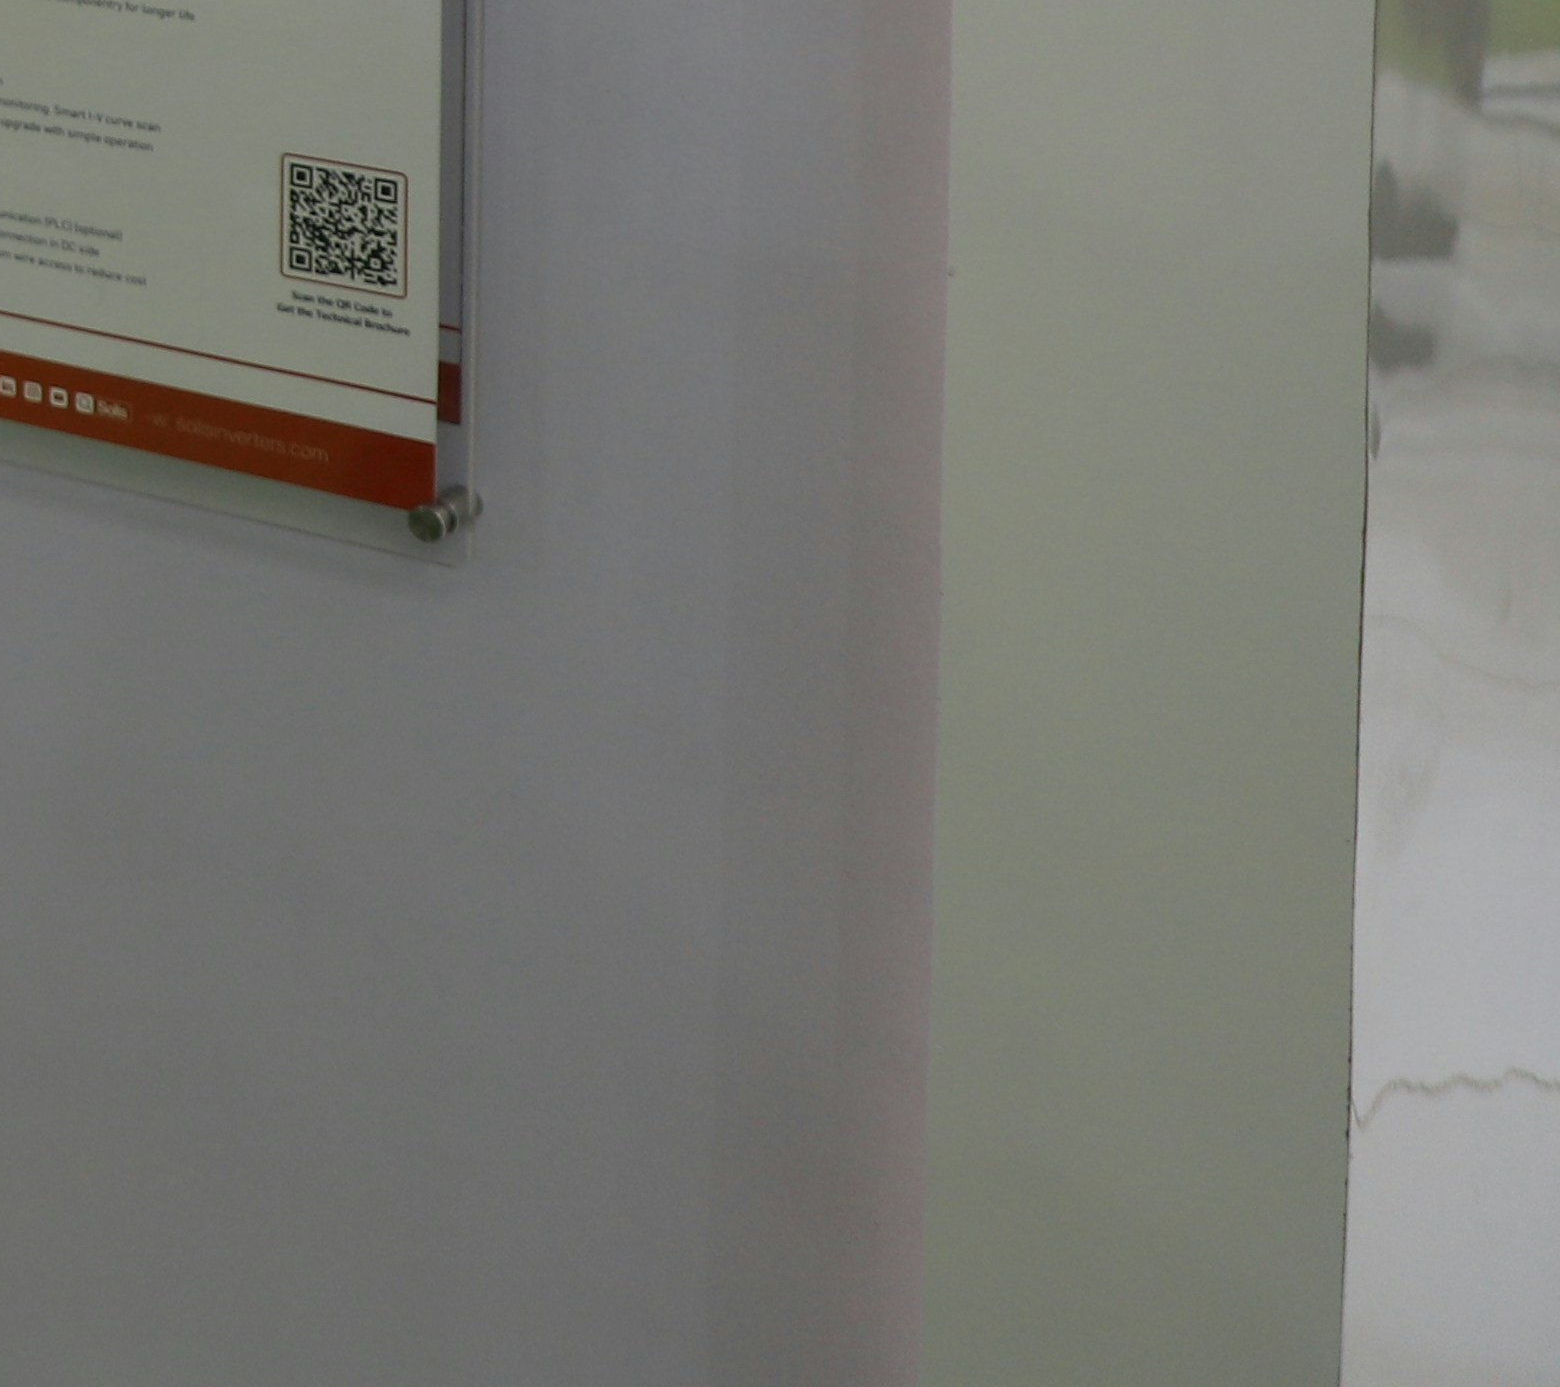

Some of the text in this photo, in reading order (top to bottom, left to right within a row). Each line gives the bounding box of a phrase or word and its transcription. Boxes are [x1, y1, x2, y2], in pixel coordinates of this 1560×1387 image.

[124, 0, 139, 13] for
[142, 3, 176, 20] longer
[178, 7, 195, 21] life
[54, 104, 86, 120] Smart
[105, 115, 134, 128] curve
[136, 120, 161, 133] scan
[0, 117, 41, 131] upgrade
[44, 124, 65, 136] with
[68, 128, 101, 143] simple
[104, 133, 154, 151] operation
[14, 250, 35, 264] wire
[38, 256, 73, 272] access
[74, 263, 85, 274] to
[87, 266, 122, 281] reduce
[276, 302, 410, 336] Get the Technical Brochure
[292, 290, 393, 318] Scan the QR Code to
